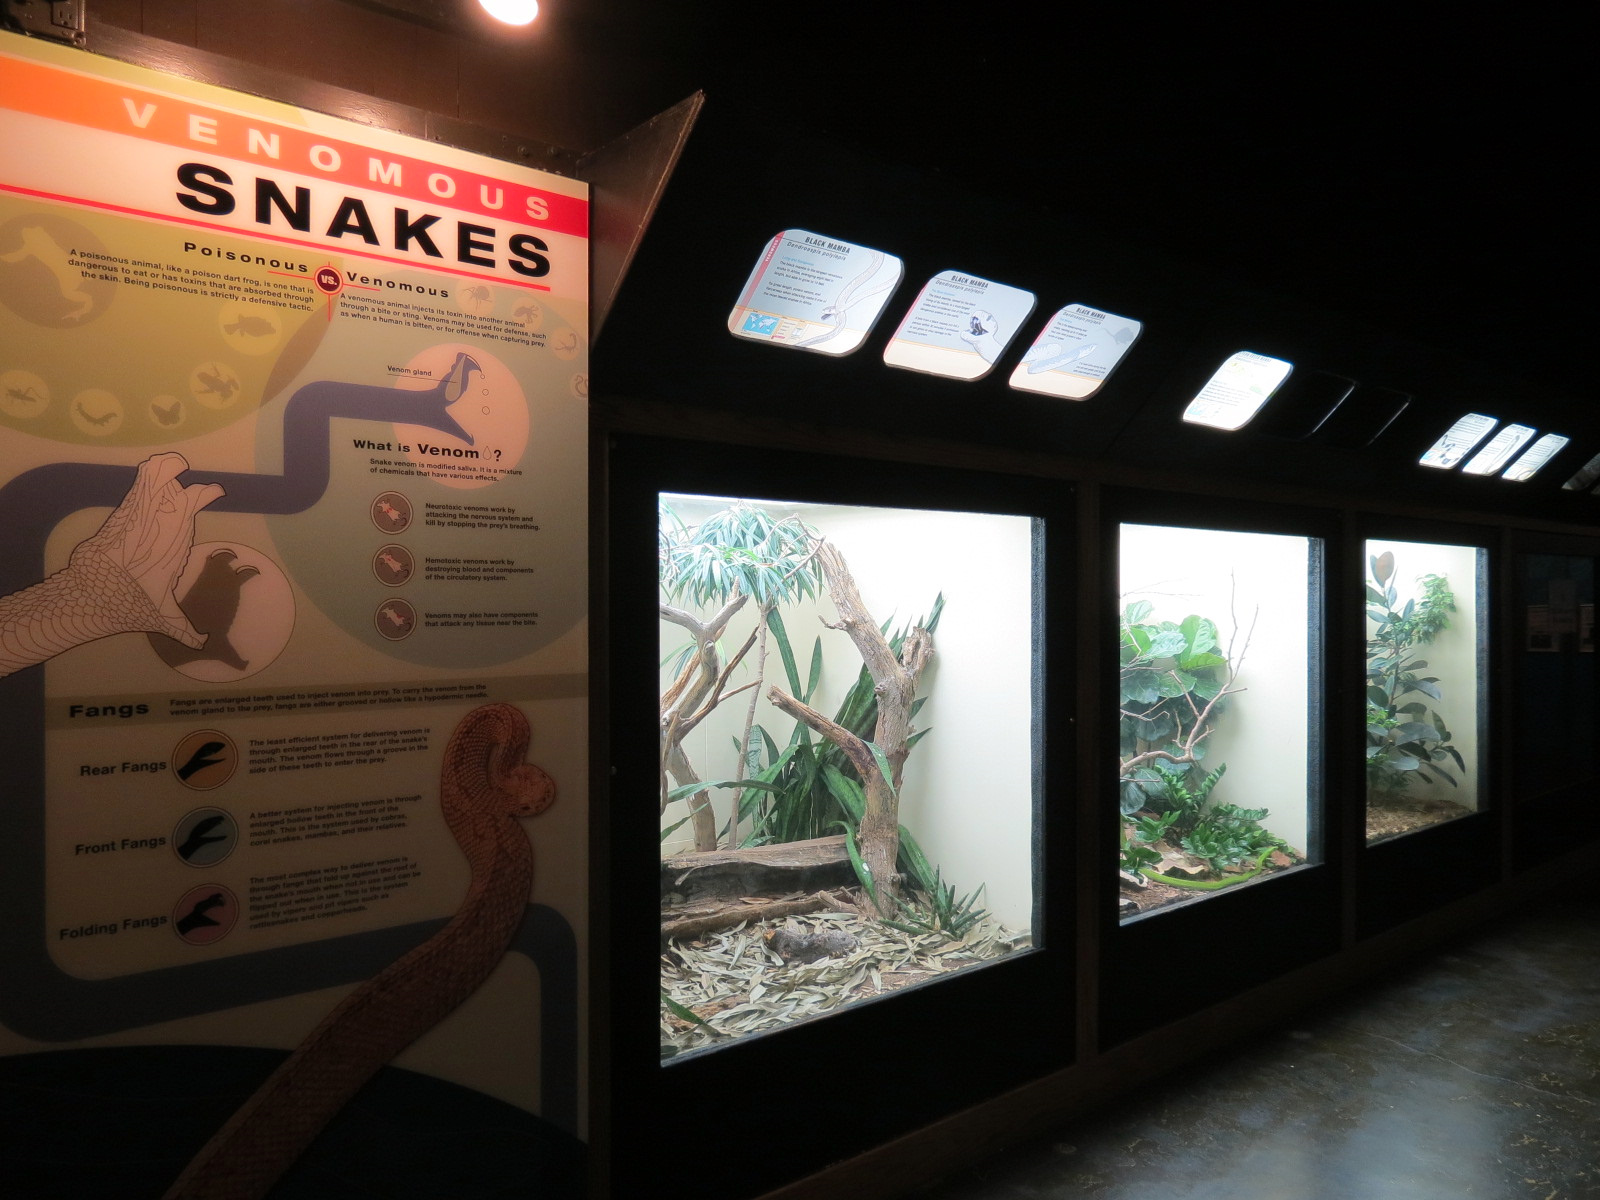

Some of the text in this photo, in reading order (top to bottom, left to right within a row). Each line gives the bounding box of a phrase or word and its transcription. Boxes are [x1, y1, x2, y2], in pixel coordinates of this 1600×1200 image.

[123, 97, 549, 220] VENOMOUS
[176, 162, 551, 278] SNAKES
[805, 237, 850, 254] BLACK MAMBA
[184, 242, 307, 272] Poisonous
[68, 257, 118, 272] dangerous
[121, 266, 130, 274] to
[133, 269, 147, 277] eat
[162, 272, 178, 282] has
[180, 275, 206, 286] toxins
[209, 279, 226, 289] that
[244, 285, 282, 298] absorbed
[284, 290, 314, 304] through
[70, 247, 77, 256] A
[79, 250, 128, 264] poisonous
[131, 259, 164, 271] animal,
[166, 263, 182, 273] like
[192, 268, 221, 279] poison
[223, 272, 240, 282] dart
[242, 275, 261, 287] frog,
[264, 278, 270, 287] is
[273, 282, 287, 290] one
[290, 283, 305, 293] that
[307, 286, 314, 294] is
[81, 269, 96, 279] the
[99, 273, 120, 283] skin.
[124, 276, 150, 289] Being
[152, 281, 198, 294] poisonous
[200, 287, 208, 296] is
[210, 289, 239, 302] strictly
[248, 294, 287, 307] defensive
[289, 300, 313, 311] tactic.
[347, 272, 448, 297] Venomous
[951, 275, 989, 288] BLACK MAMBA
[340, 300, 369, 312] through
[377, 306, 391, 315] bite
[402, 310, 421, 321] sting.
[423, 313, 449, 324] Venoms
[451, 319, 465, 328] may
[466, 320, 474, 328] be
[493, 324, 502, 332] for
[504, 326, 530, 338] defense,
[348, 294, 385, 306] venomous
[387, 300, 410, 310] animal
[411, 303, 434, 313] injects
[436, 307, 444, 315] its
[446, 308, 463, 318] toxin
[464, 311, 477, 320] into
[478, 315, 502, 324] another
[504, 318, 525, 328] animal
[351, 312, 370, 320] when
[378, 315, 403, 325] human
[412, 320, 434, 331] bitten,
[444, 324, 454, 333] for
[456, 327, 480, 337] offense
[481, 331, 498, 340] when
[500, 334, 530, 346] capturing
[531, 339, 544, 348] prey.
[387, 365, 432, 376] Venom gland
[354, 439, 501, 461] What is Venom ?
[370, 457, 392, 466] Snake
[426, 462, 456, 470] modified
[457, 464, 478, 472] saliva.
[498, 467, 522, 475] mixture
[379, 467, 415, 476] chemicals
[416, 469, 430, 477] that
[431, 470, 447, 478] have
[449, 472, 473, 480] various
[475, 473, 499, 482] effects.
[425, 511, 457, 520] attacking
[437, 520, 445, 528] by
[447, 520, 476, 529] stopping
[425, 565, 460, 574] destroying
[446, 574, 481, 582] circulatory
[70, 704, 149, 718] Fangs
[80, 761, 166, 776] Rear Fangs
[75, 836, 166, 855] Front Fangs
[60, 915, 168, 939] Folding Fangs
